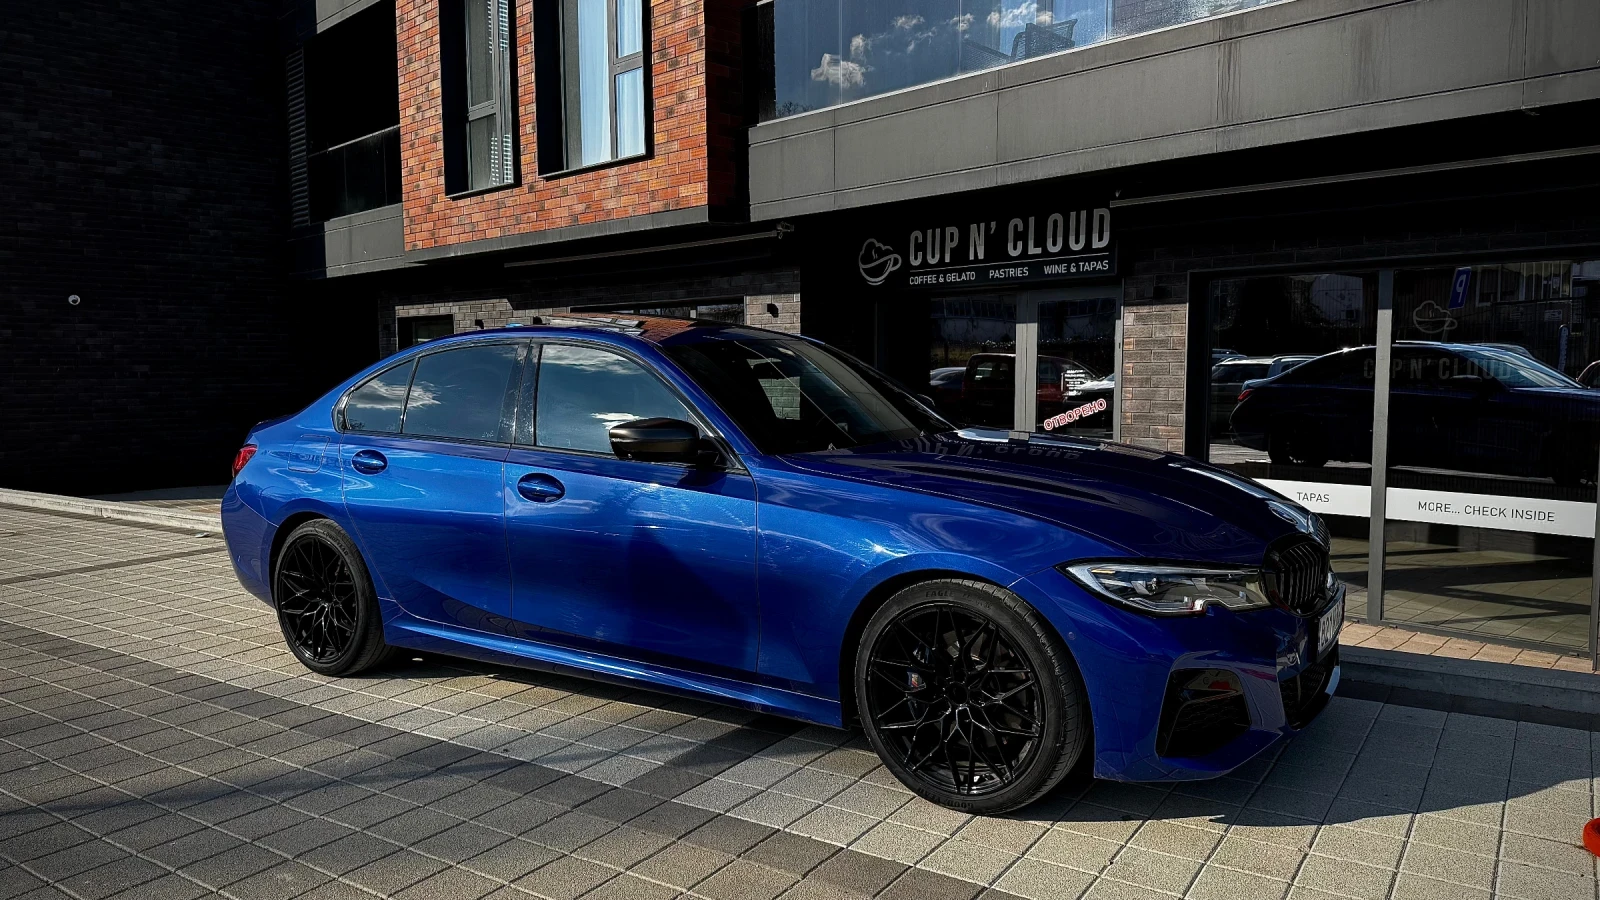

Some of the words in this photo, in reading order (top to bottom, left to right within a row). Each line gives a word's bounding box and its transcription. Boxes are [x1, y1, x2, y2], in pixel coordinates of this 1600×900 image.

[909, 226, 959, 267] CUP
[1007, 207, 1111, 257] CLOUD
[909, 272, 937, 286] COFFEE
[938, 274, 945, 283] &
[946, 271, 976, 283] GELATO
[989, 266, 1029, 279] PASTRIES
[1043, 263, 1067, 275] WINE
[1069, 263, 1077, 273] &
[1078, 259, 1109, 272] TAPAS
[1363, 357, 1402, 379] CP
[1438, 357, 1511, 380] CLOUD
[1043, 398, 1107, 431] ОТВОРЕНО
[1296, 491, 1330, 503] TAPAS
[1418, 500, 1460, 514] MORE...
[1464, 504, 1507, 518] CHECK
[1510, 509, 1555, 522] INSIDE
